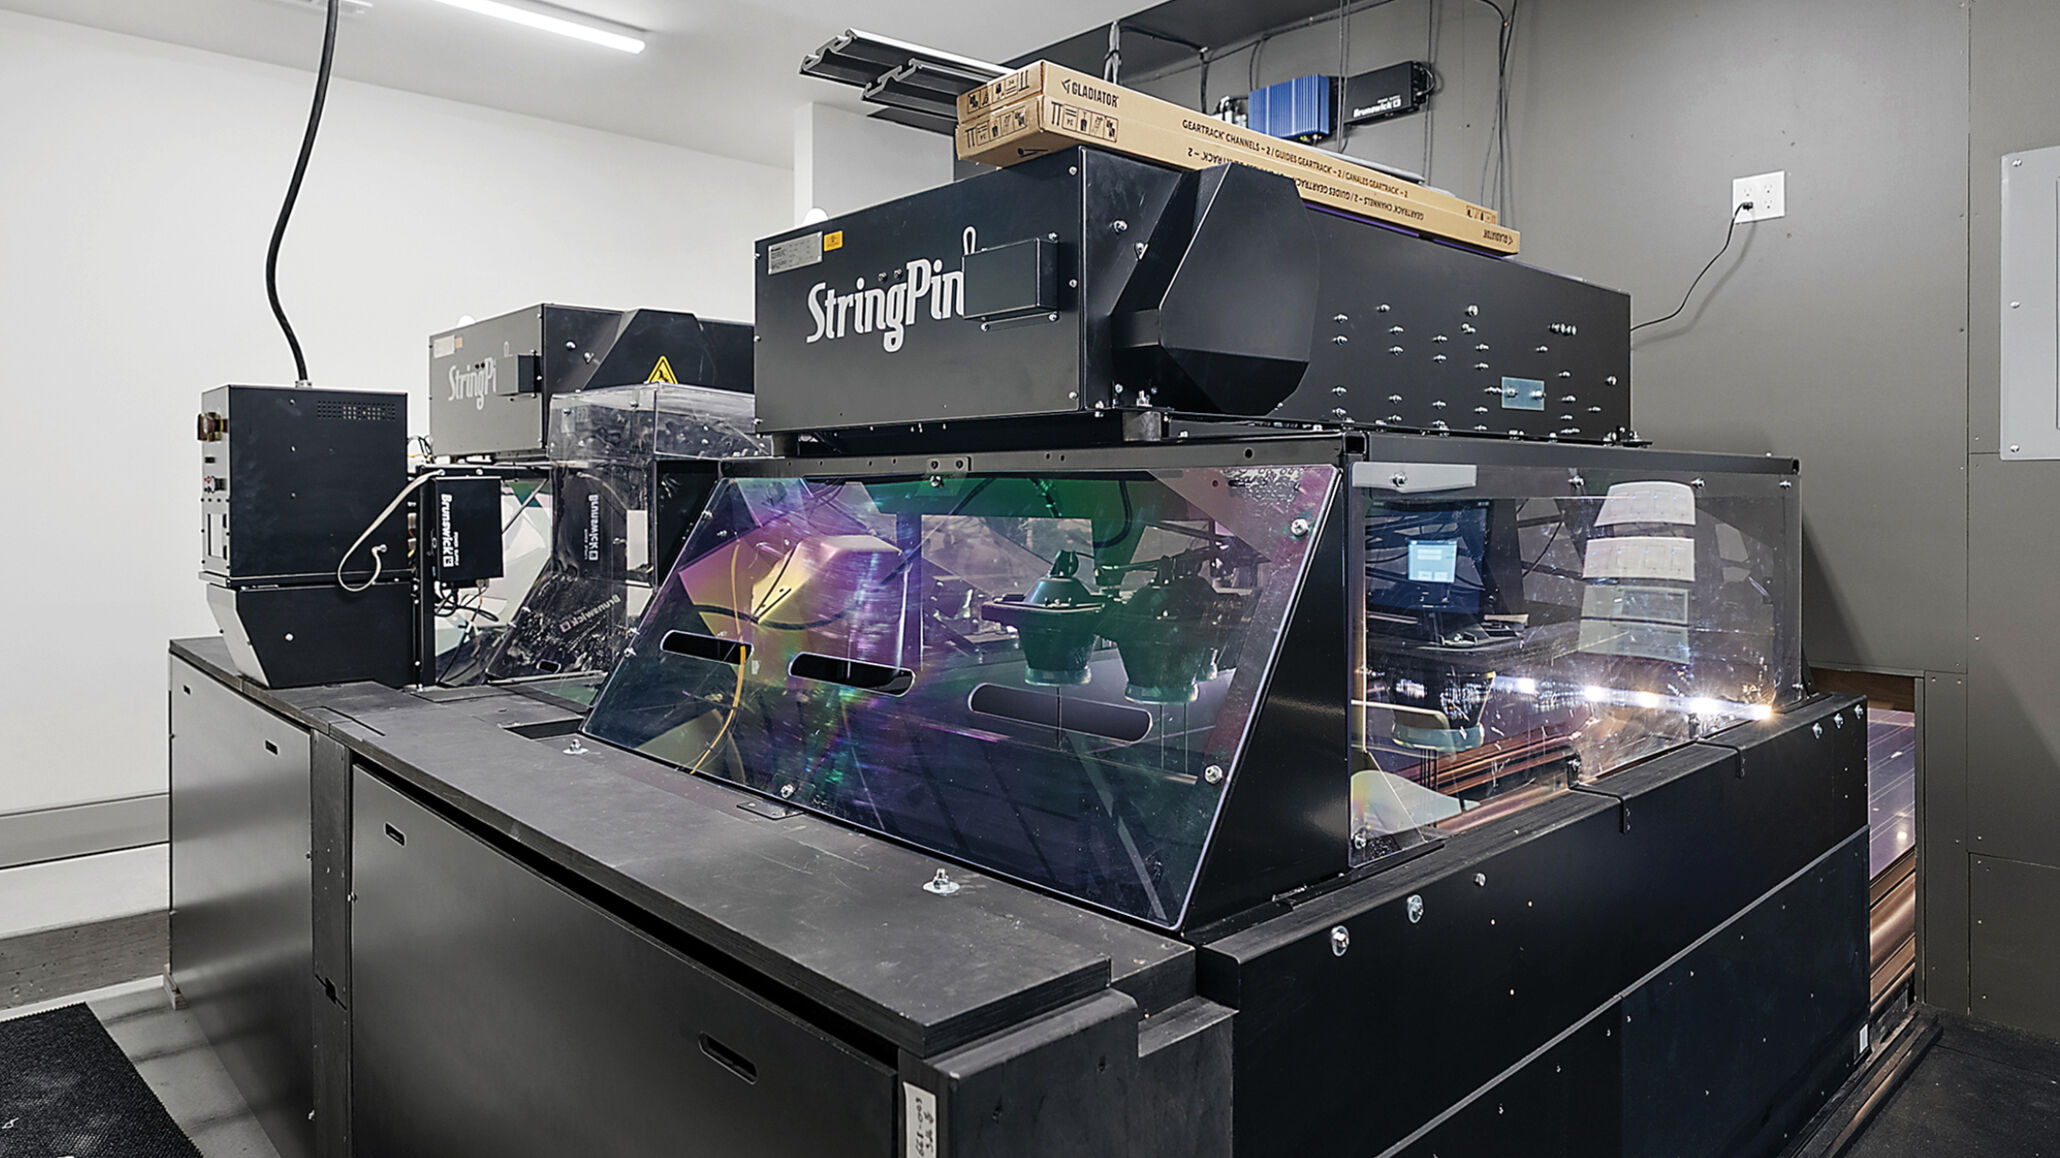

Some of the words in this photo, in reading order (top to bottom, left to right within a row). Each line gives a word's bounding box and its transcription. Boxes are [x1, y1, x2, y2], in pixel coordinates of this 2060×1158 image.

[1071, 82, 1119, 108] GLADIATOR
[1225, 134, 1260, 152] CHANNELS
[1275, 149, 1298, 164] GUIDES
[448, 357, 497, 410] StringPi
[441, 493, 454, 555] Brunswick
